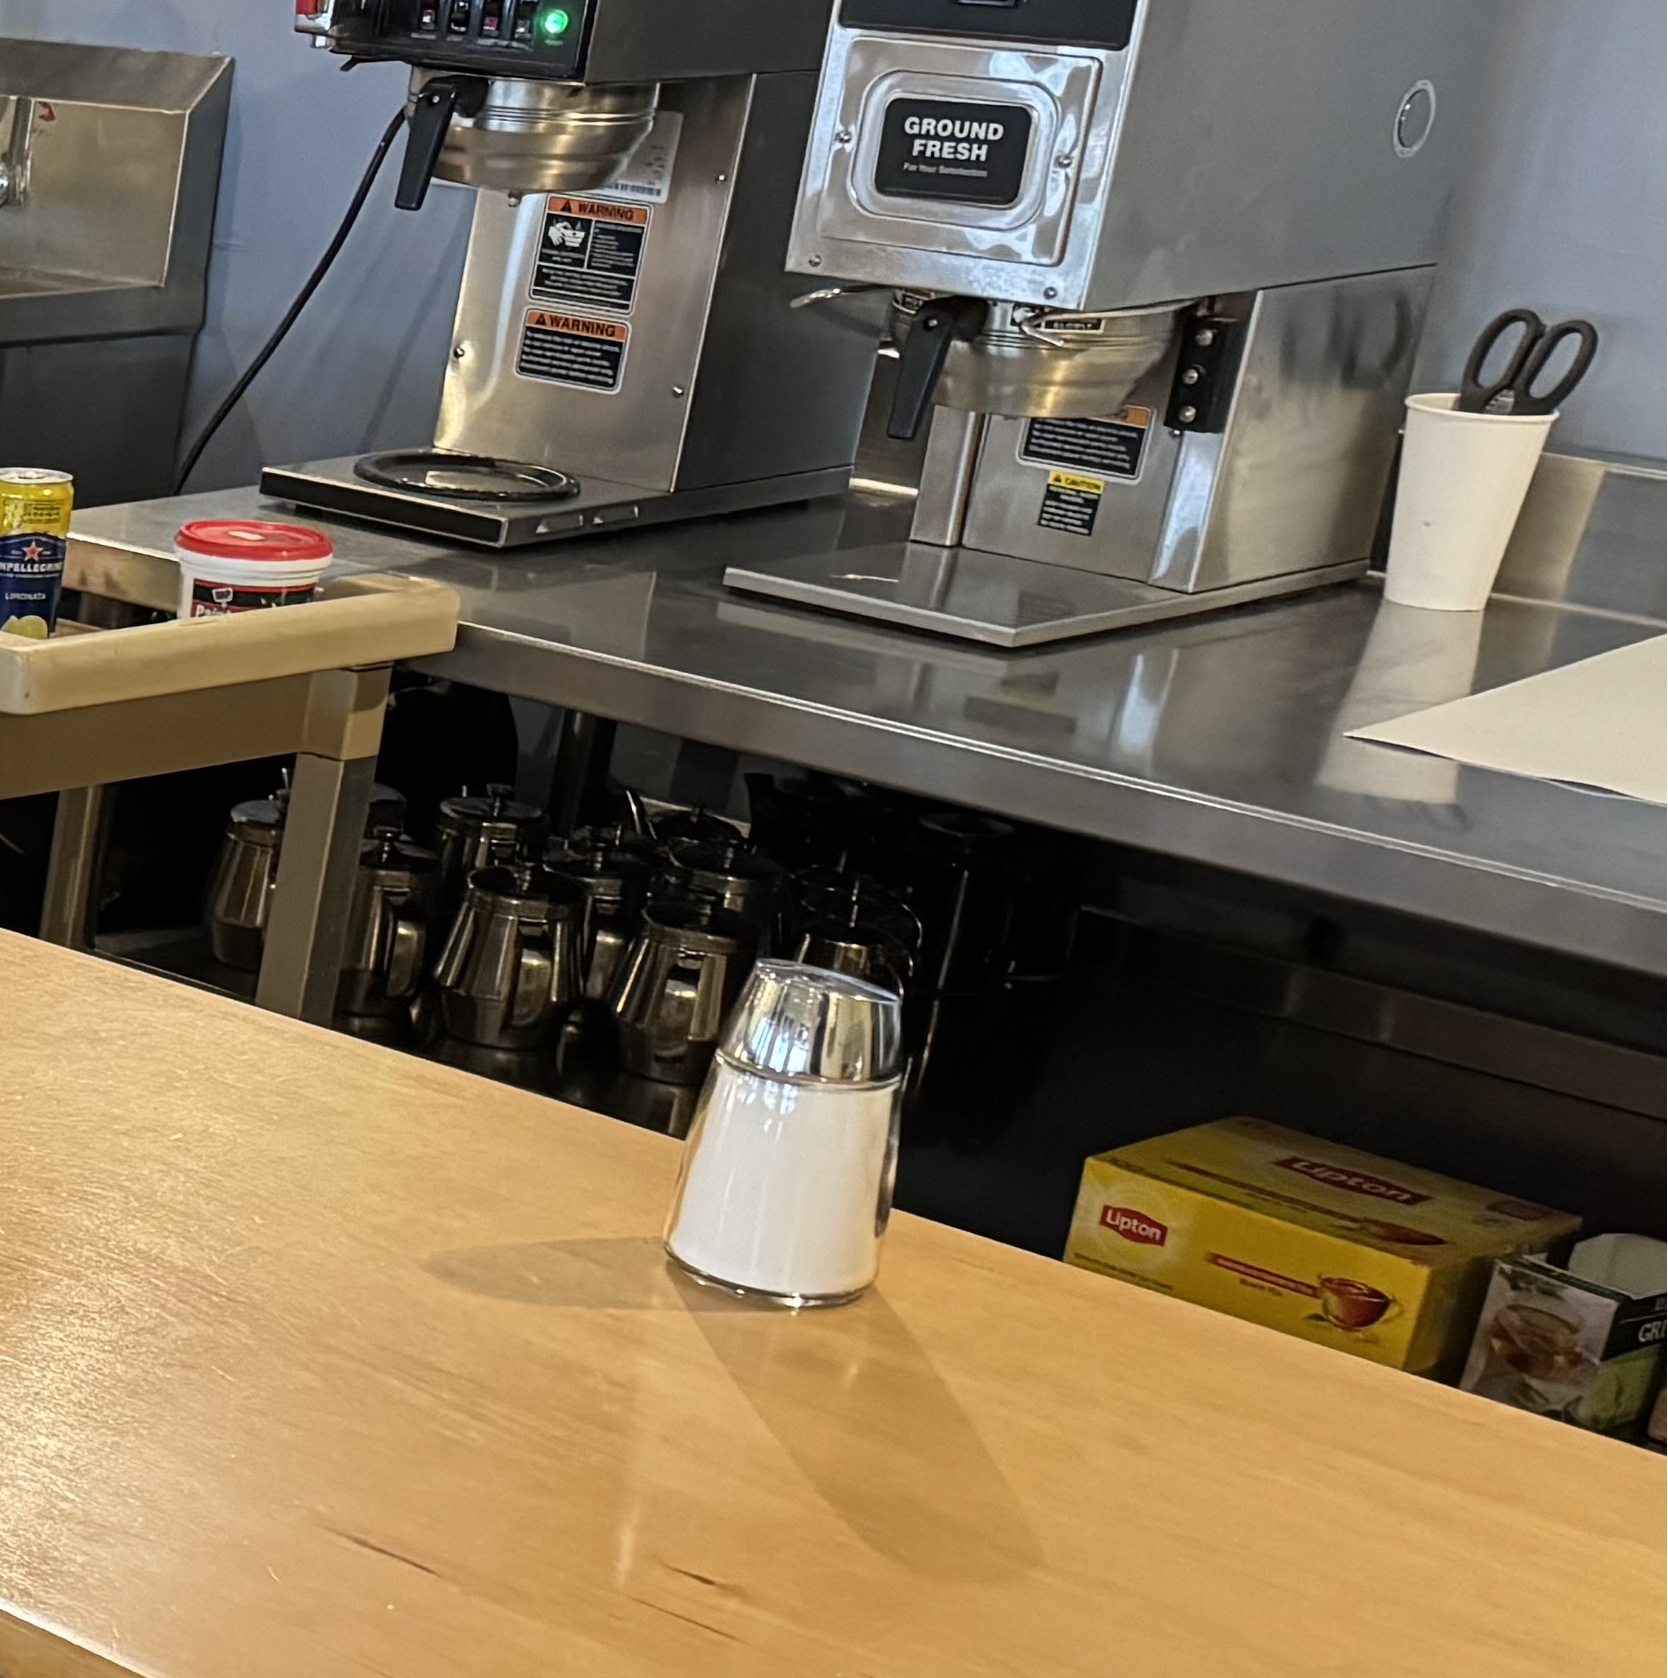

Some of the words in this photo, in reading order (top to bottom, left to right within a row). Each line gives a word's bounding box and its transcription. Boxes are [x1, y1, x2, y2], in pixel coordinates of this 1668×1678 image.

[904, 117, 1004, 140] GROUND
[912, 139, 988, 162] FRESH
[579, 203, 634, 220] WARNING
[550, 316, 616, 338] WARNING
[1290, 1158, 1413, 1203] Lipton
[1106, 1208, 1162, 1242] Lipton
